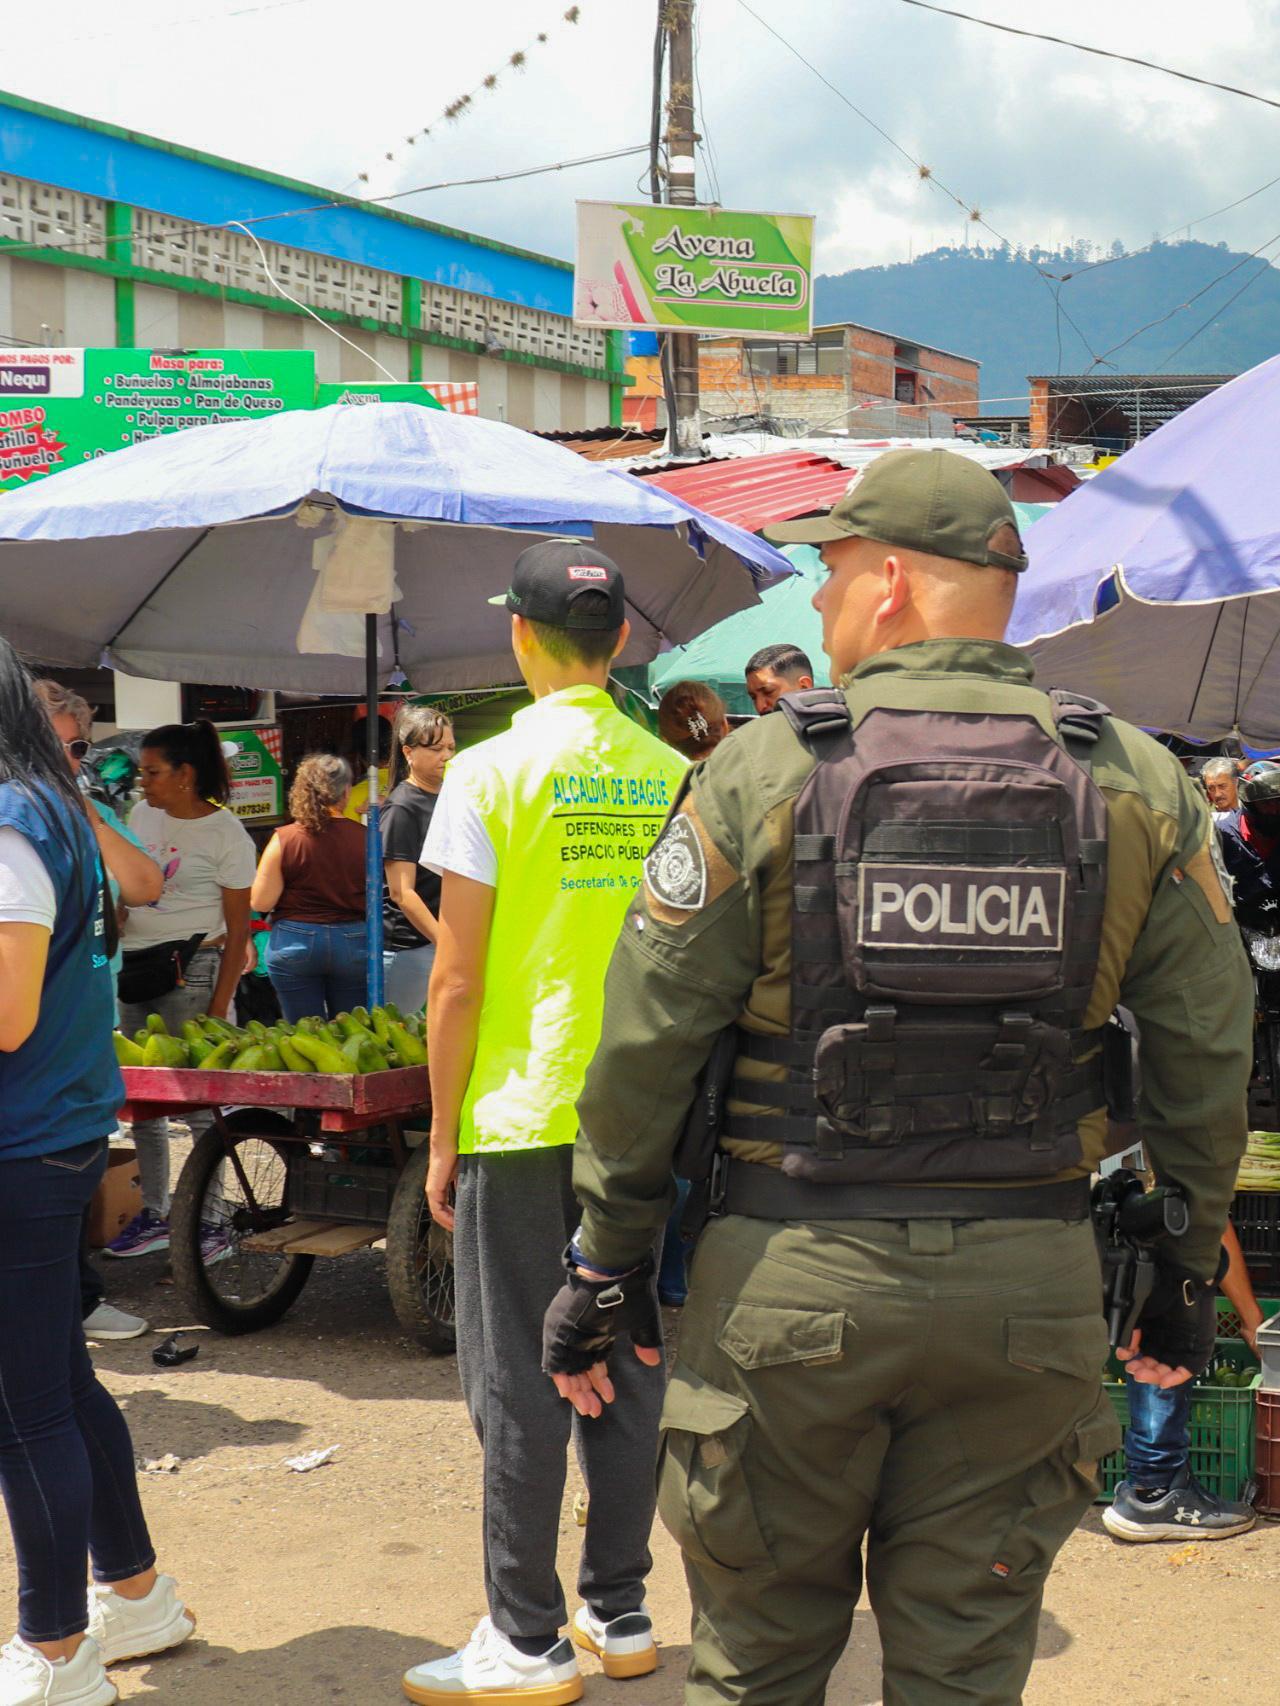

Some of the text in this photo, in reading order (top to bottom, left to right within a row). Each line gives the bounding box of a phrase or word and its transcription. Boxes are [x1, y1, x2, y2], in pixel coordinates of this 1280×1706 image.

[653, 225, 754, 259] Avena
[656, 264, 796, 297] La Abuela
[20, 354, 49, 364] PAGOS
[151, 357, 224, 371] Masa para:
[1, 370, 46, 389] Nequi
[116, 375, 272, 390] Buñuelos Almojábanas
[107, 394, 282, 410] Pandeyucas Pan de Queso
[138, 412, 174, 427] Pulpa
[178, 416, 208, 429] para
[0, 449, 55, 469] uñuelo
[554, 765, 669, 806] ALCALDÍA DE IBAGUÉ
[566, 822, 635, 837] DEFENSORES
[561, 840, 648, 861] ESPACIO PÚBL
[561, 873, 614, 889] Secretaría
[871, 882, 1052, 936] POLICIA
